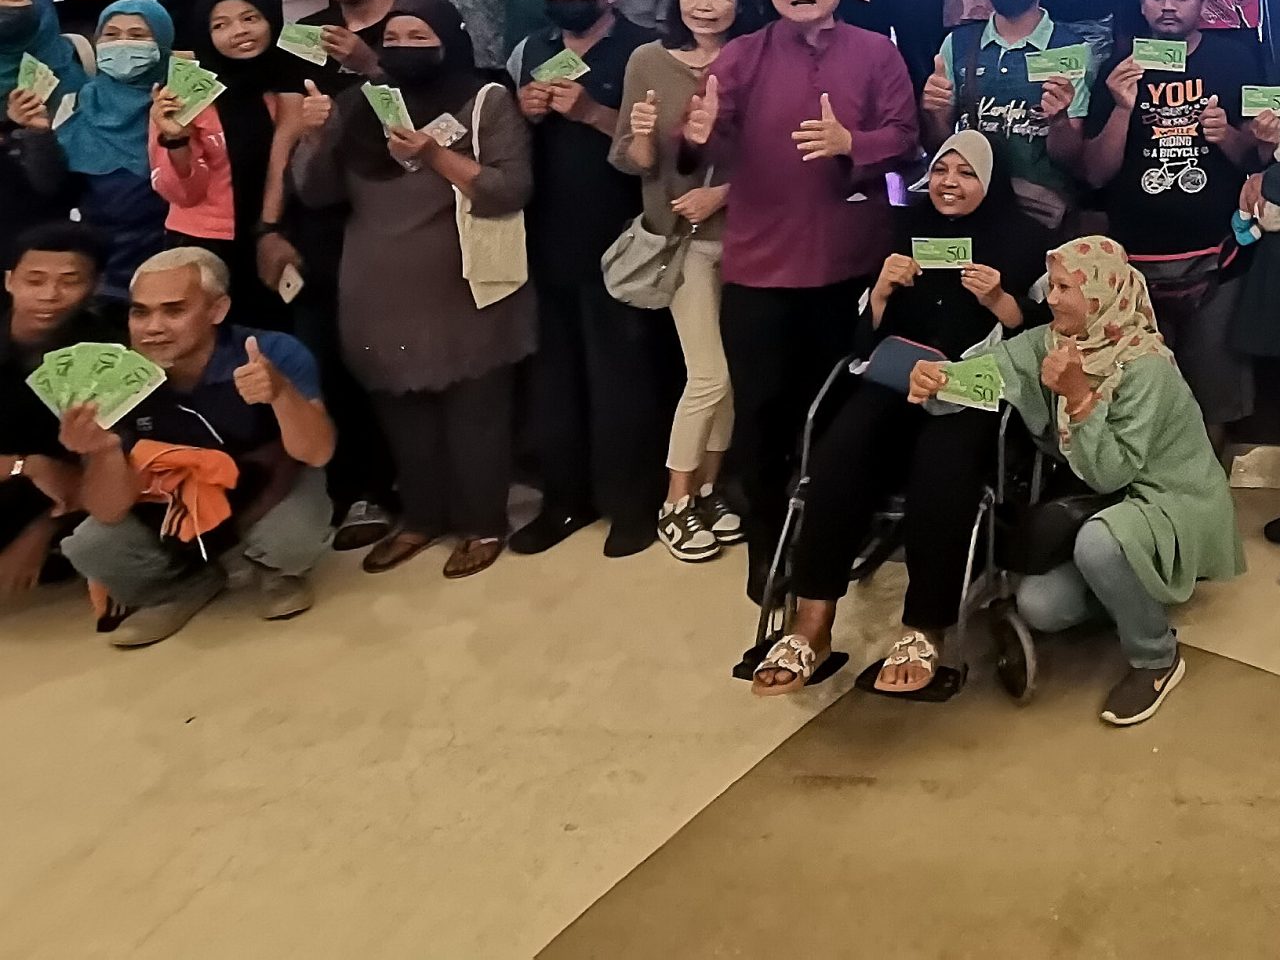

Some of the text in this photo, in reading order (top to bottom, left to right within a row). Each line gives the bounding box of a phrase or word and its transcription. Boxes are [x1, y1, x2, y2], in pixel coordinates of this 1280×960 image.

[1162, 48, 1183, 65] 50
[1147, 78, 1203, 107] YOU
[1150, 146, 1200, 158] A BICYCLE
[945, 246, 967, 263] 50
[972, 384, 994, 403] 50
